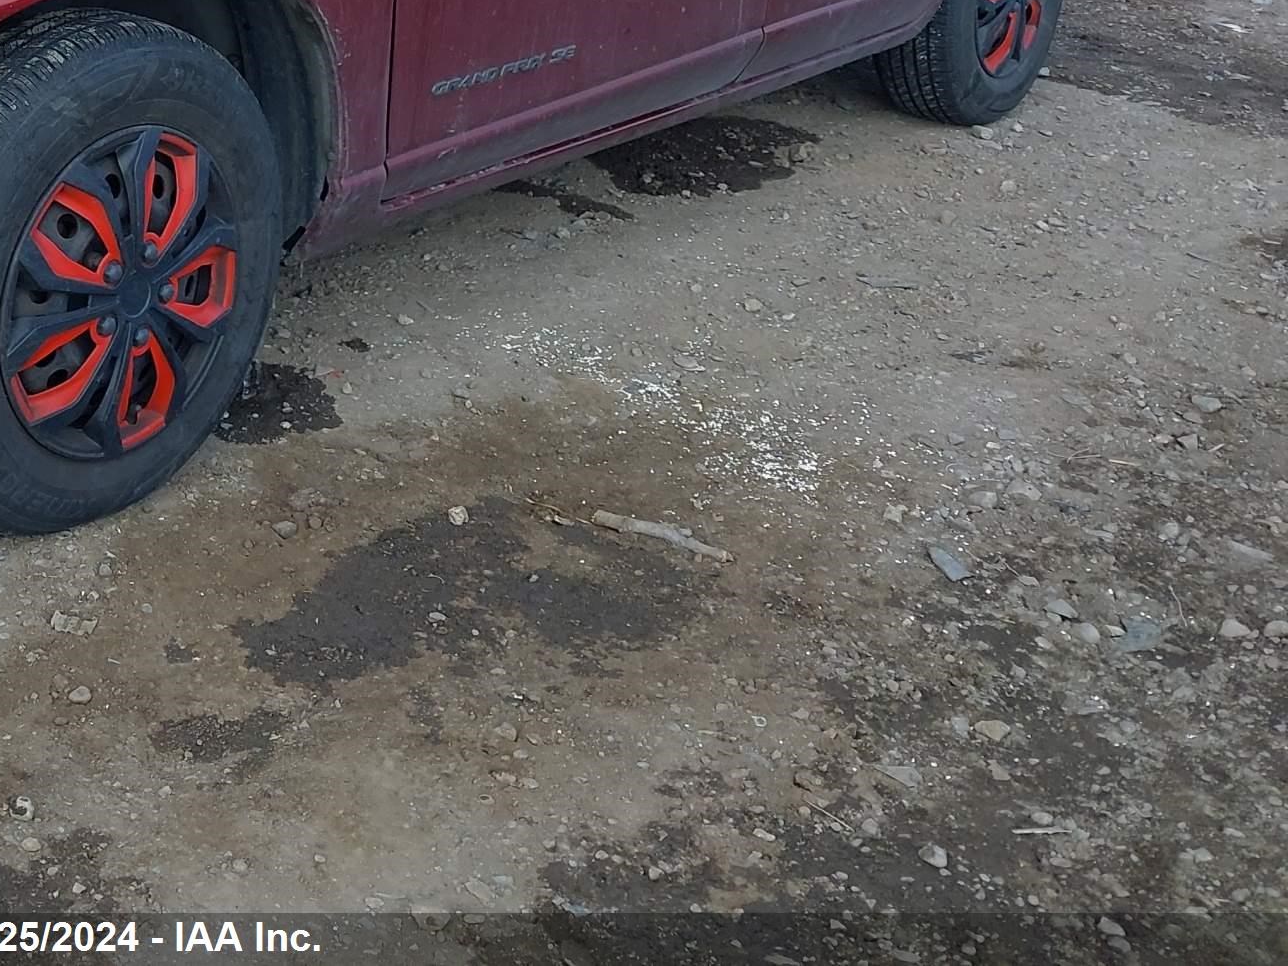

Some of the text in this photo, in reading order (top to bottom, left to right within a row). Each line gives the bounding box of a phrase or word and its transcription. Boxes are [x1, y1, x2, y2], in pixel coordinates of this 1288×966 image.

[431, 44, 577, 95] GRAND PRIX SE
